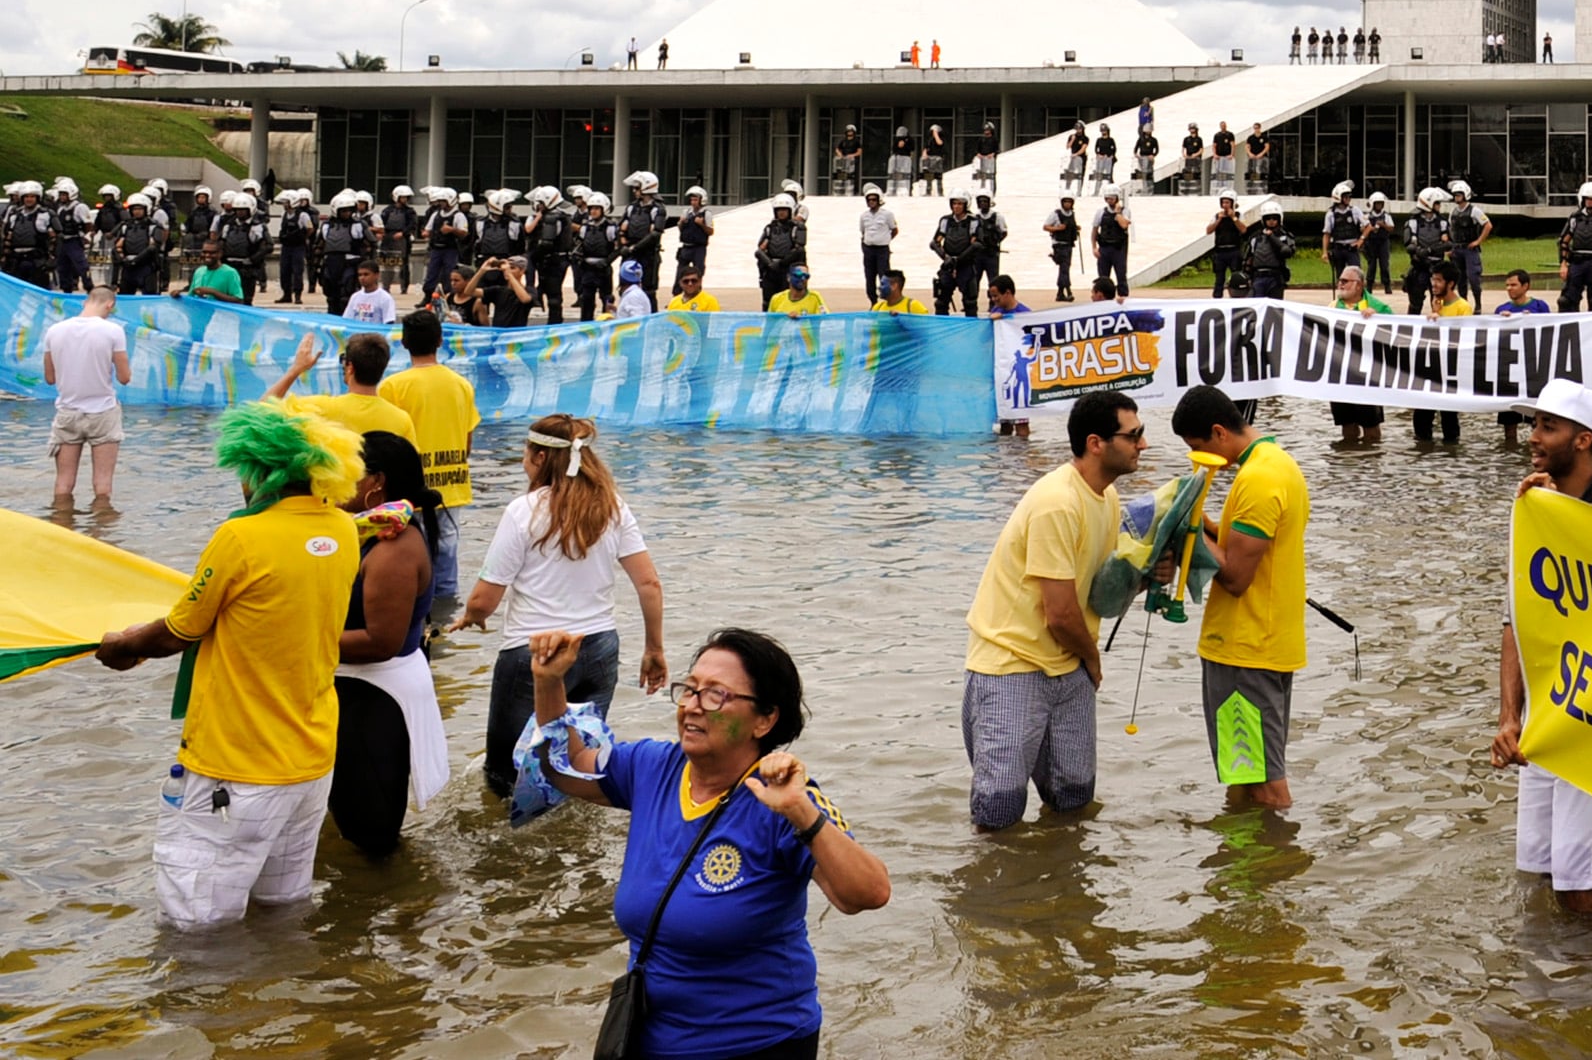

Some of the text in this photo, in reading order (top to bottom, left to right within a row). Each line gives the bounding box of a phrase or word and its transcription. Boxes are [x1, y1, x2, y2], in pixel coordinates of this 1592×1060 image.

[1050, 313, 1134, 345] LIMPA
[1038, 335, 1151, 382] BRASIL
[1175, 306, 1285, 387] FORA
[1294, 313, 1461, 395] DILMA!
[1473, 321, 1584, 398] LEVA
[1073, 386, 1081, 395] DE
[1115, 378, 1147, 389] CORRUPÇÃO
[424, 467, 469, 488] ORRUPÇÃO!
